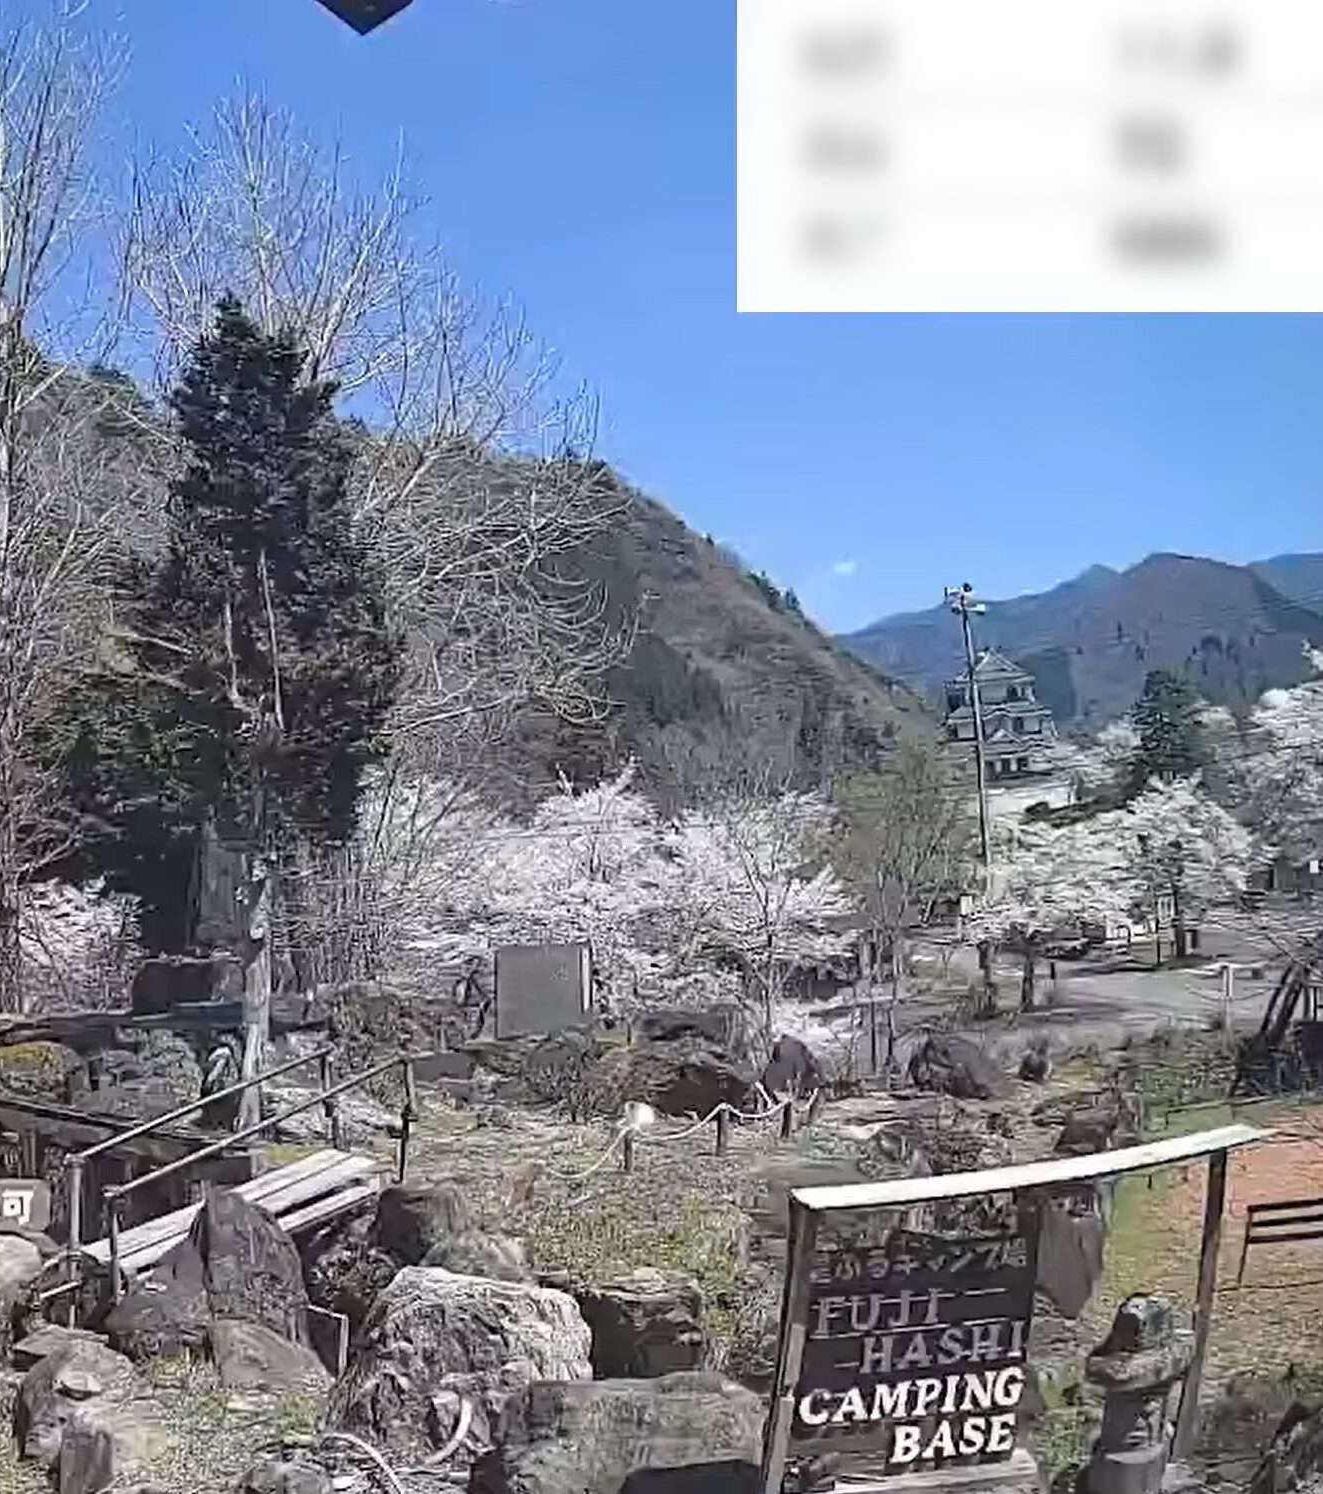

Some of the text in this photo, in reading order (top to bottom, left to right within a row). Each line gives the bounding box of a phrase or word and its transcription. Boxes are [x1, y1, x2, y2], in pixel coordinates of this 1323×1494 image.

[816, 1289, 942, 1335] FUJI
[859, 1321, 1026, 1374] HASHI
[799, 1367, 1025, 1425] CAMPING
[889, 1414, 1016, 1464] BASE
